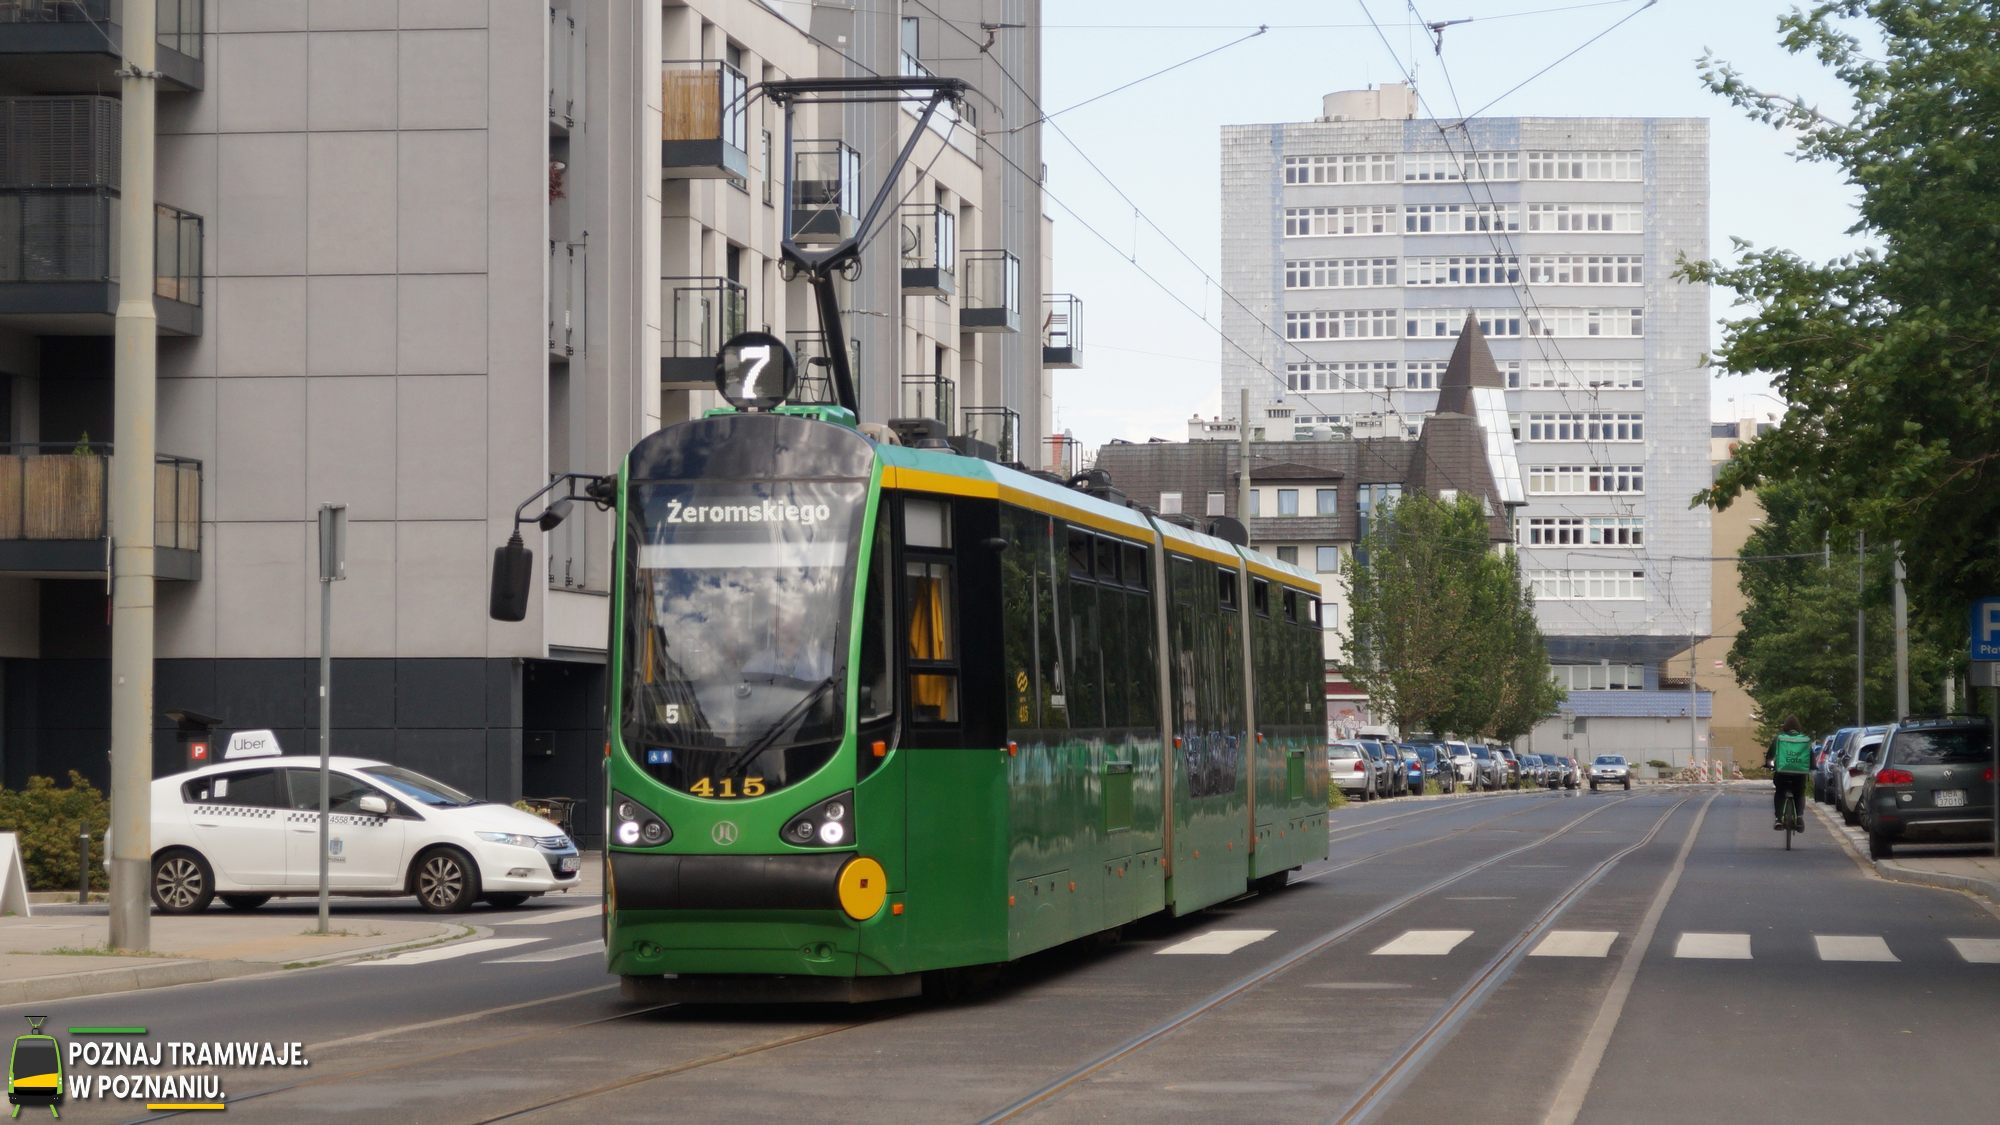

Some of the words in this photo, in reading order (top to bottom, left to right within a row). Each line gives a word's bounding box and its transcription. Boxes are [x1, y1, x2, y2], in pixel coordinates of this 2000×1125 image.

[741, 345, 770, 399] 7
[667, 499, 830, 525] Żeromskiego
[666, 704, 679, 724] 5
[195, 746, 204, 757] P
[234, 739, 266, 750] Uber
[690, 777, 766, 797] 415
[329, 815, 349, 824] 4558
